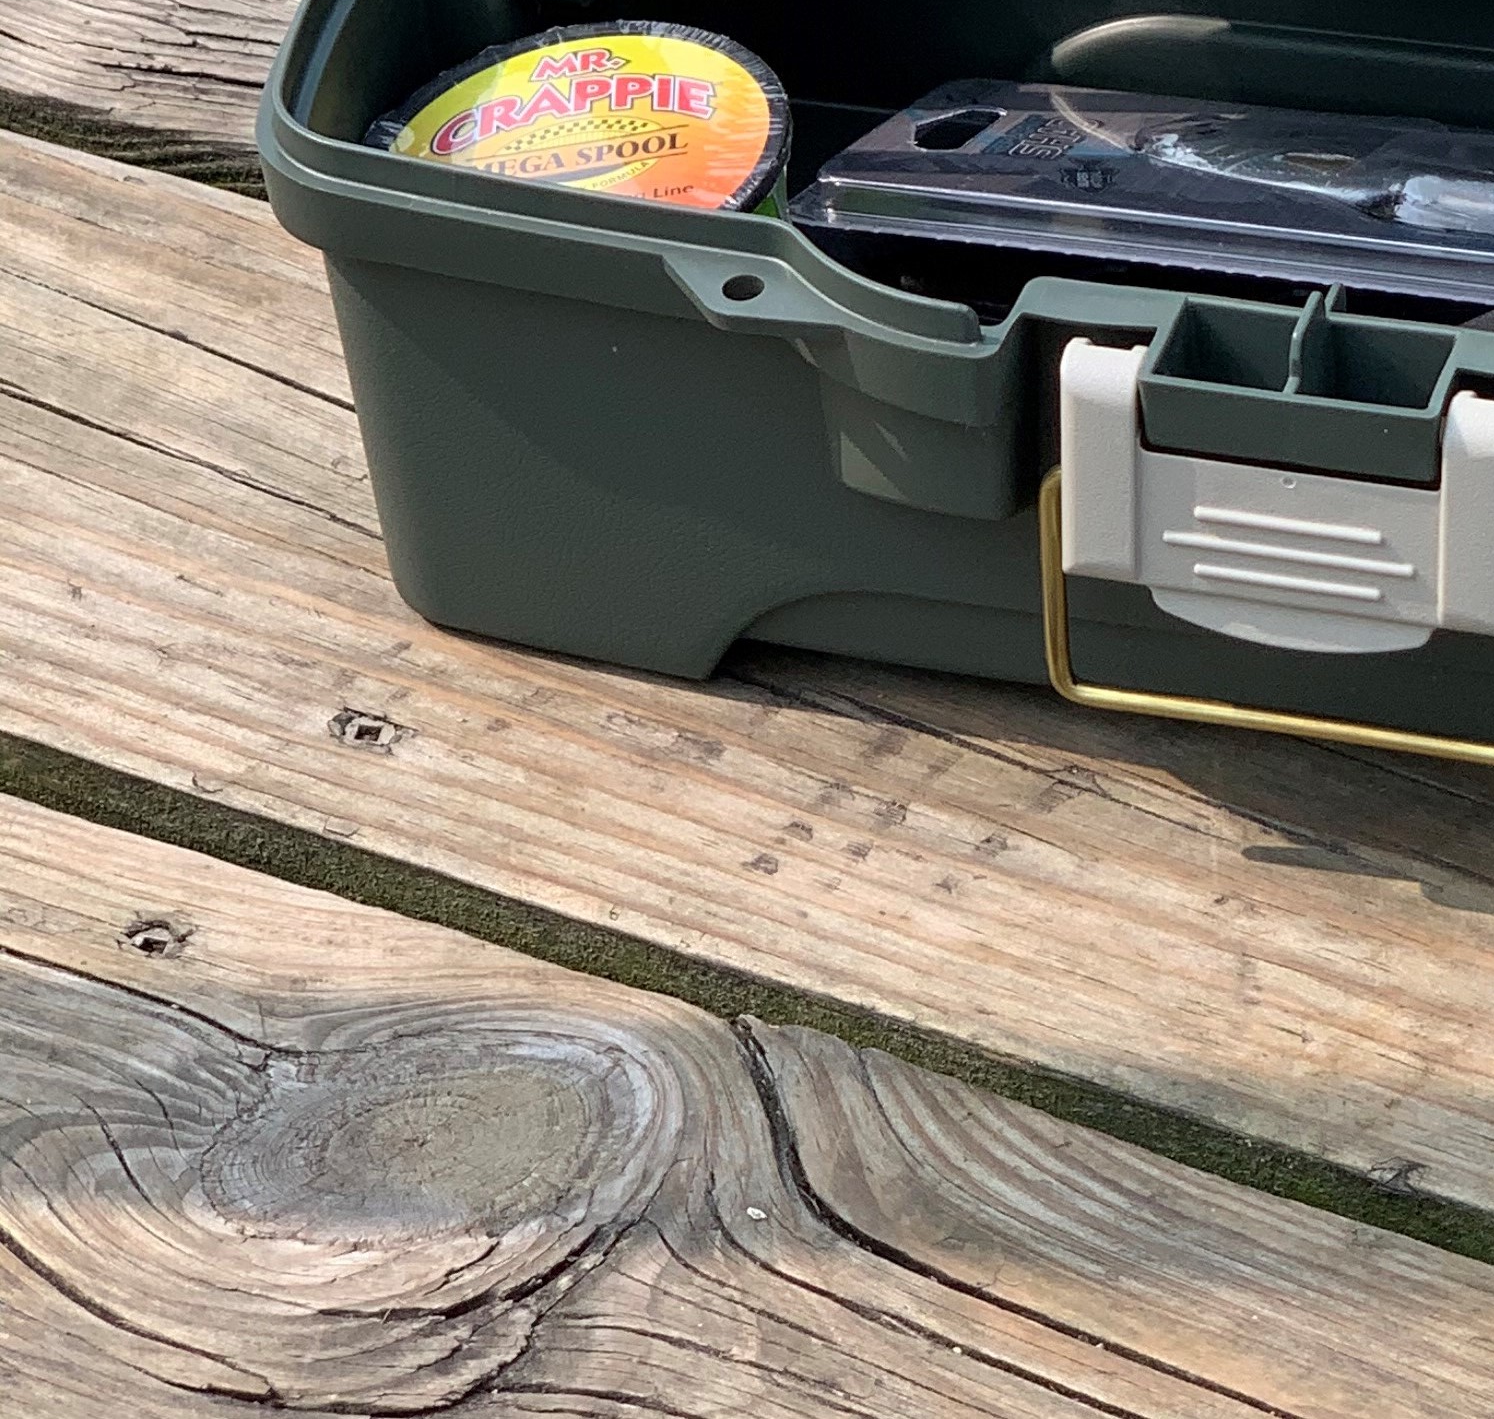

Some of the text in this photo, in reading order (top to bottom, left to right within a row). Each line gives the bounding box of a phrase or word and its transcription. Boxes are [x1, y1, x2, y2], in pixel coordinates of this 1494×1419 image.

[530, 48, 631, 81] MR.
[430, 73, 717, 156] CRAPPIE
[575, 132, 690, 166] SPOOL
[591, 160, 651, 189] FORMULA
[652, 184, 695, 199] Line
